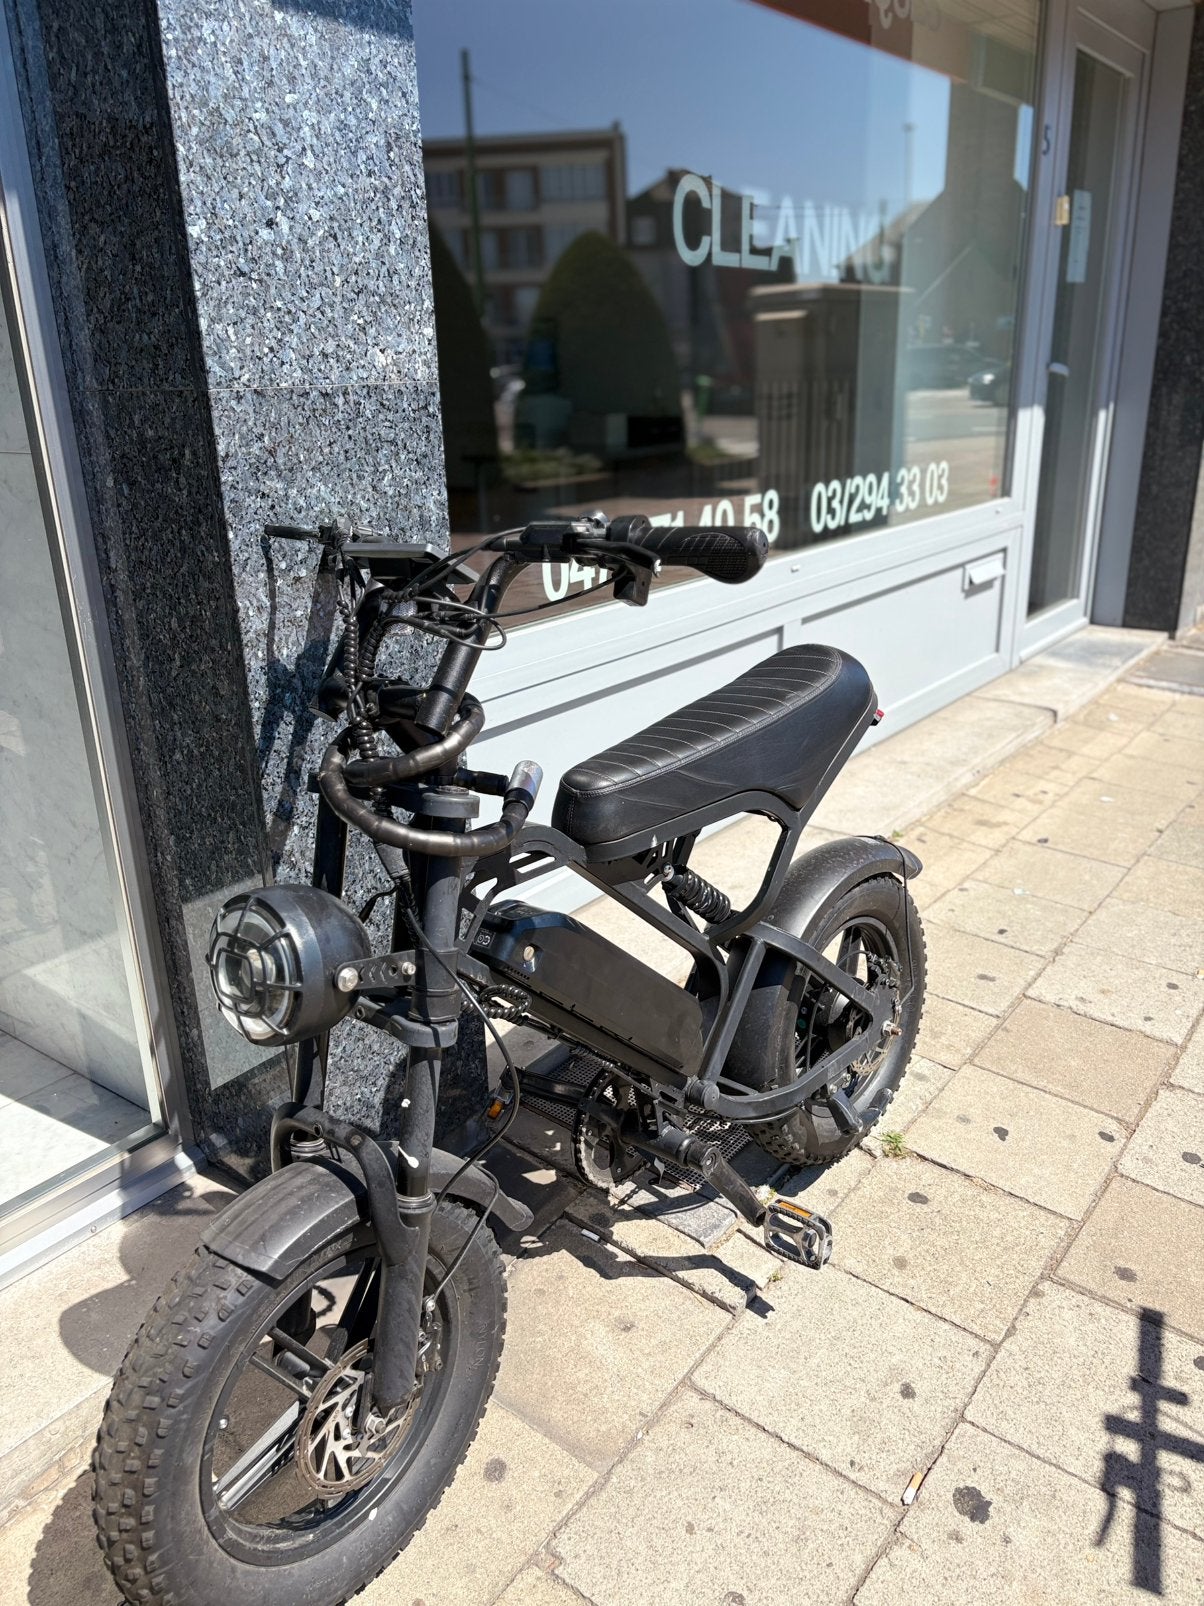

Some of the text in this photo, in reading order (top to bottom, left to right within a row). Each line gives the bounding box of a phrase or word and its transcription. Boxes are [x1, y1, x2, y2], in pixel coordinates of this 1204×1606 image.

[810, 460, 949, 533] 03/294 33 03
[542, 557, 609, 602] 04
[743, 489, 780, 543] 58
